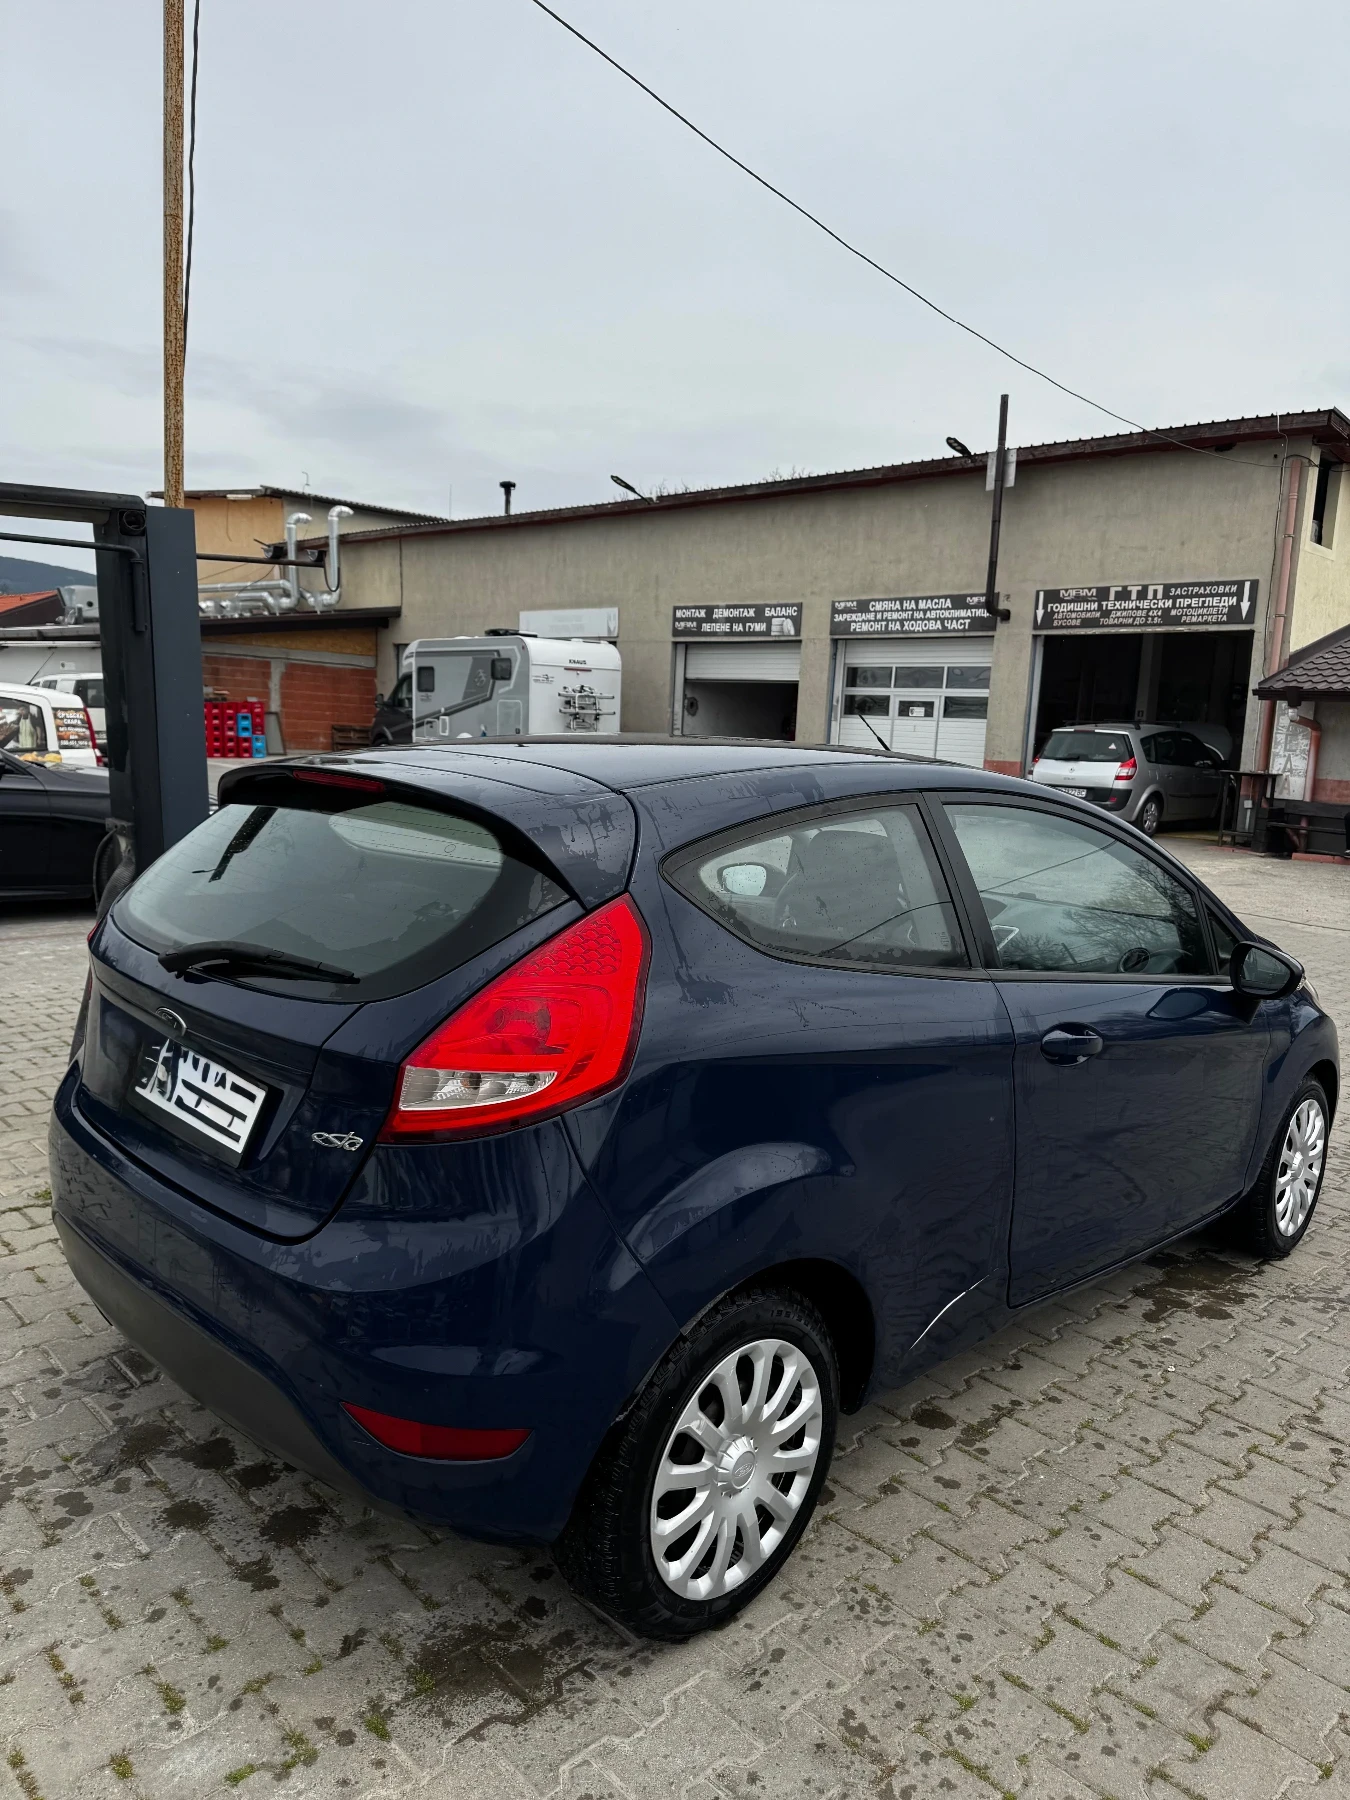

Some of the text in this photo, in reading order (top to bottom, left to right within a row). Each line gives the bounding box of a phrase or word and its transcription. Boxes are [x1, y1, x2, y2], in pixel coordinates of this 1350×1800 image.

[1169, 584, 1238, 596] ЗАСТРАХОВКИ
[869, 598, 952, 611] СМЯНА НА МАСЛА
[1047, 595, 1237, 613] ГОДИШНИ ТЕХНИЧЕСКИ ПРЕГЛЕДИ
[675, 606, 798, 619] МОНТАЖ ДЕМОНТАЖ БАЛАНС
[833, 612, 875, 622] ЗАРЕЖДАНЕ
[876, 612, 882, 620] И
[883, 611, 913, 620] РЕМОНТ
[913, 610, 924, 619] НА
[1053, 611, 1101, 619] АВТОМОБИЛИ
[1110, 609, 1147, 618] ДЖИПОВЕ
[1170, 607, 1229, 616] МОТОЦИКЛЕТИ
[701, 622, 767, 632] ЛЕПЕНЕ НА ГУМИ
[850, 619, 971, 632] РЕМОНТ НА ХОДОВА ЧАСТ
[1053, 619, 1081, 627] БУСОВЕ
[1100, 618, 1133, 626] ТОВАРНИ
[1133, 617, 1146, 626] ДО
[1181, 614, 1227, 623] РЕМАРКЕТА
